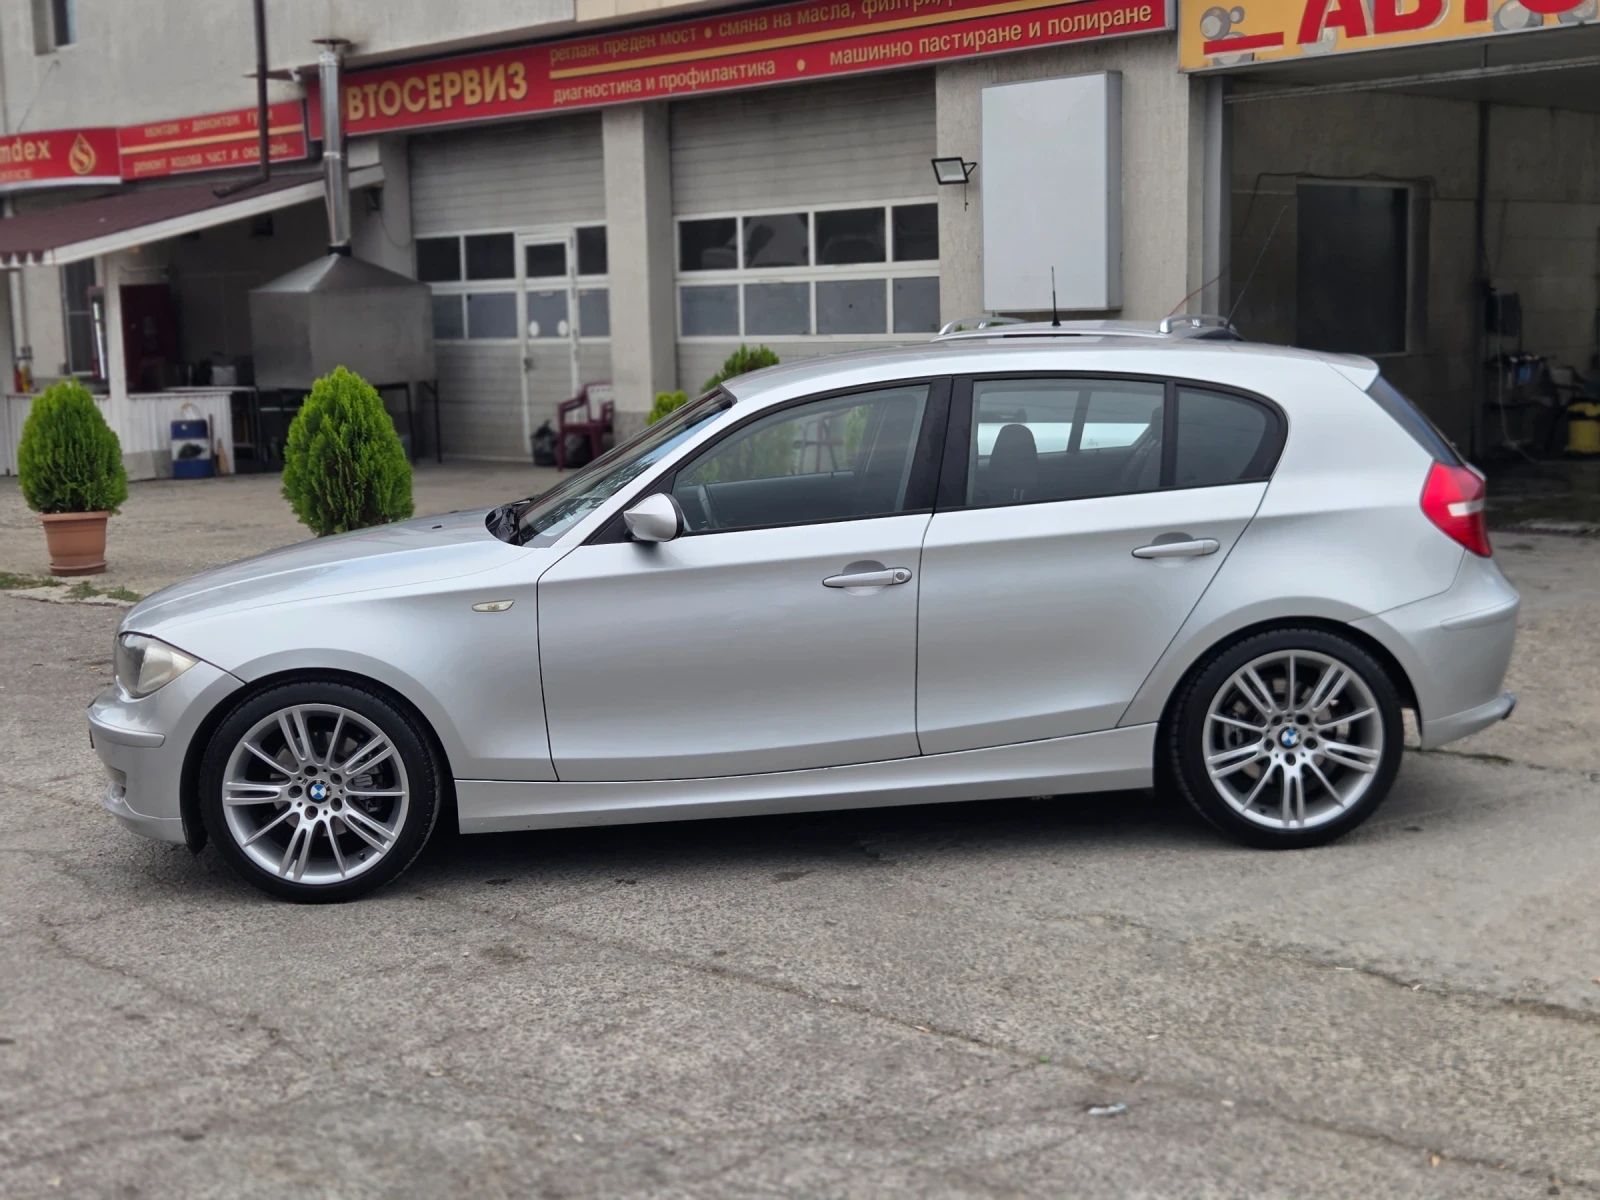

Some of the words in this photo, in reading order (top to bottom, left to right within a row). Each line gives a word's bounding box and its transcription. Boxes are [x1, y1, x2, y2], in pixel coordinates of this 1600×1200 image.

[551, 42, 600, 66] реглаж
[603, 33, 656, 56] преден
[660, 27, 697, 45] мост
[718, 17, 768, 37] смяна
[773, 12, 792, 28] на
[797, 2, 856, 26] масла,
[553, 80, 642, 104] диагностика
[646, 76, 656, 91] и
[659, 60, 776, 92] профилактика
[829, 38, 913, 66] машинно
[918, 23, 1022, 54] пастиране
[1028, 22, 1041, 38] и
[1047, 4, 1153, 36] полиране
[342, 61, 528, 121] ВТОСЕРВИЗ
